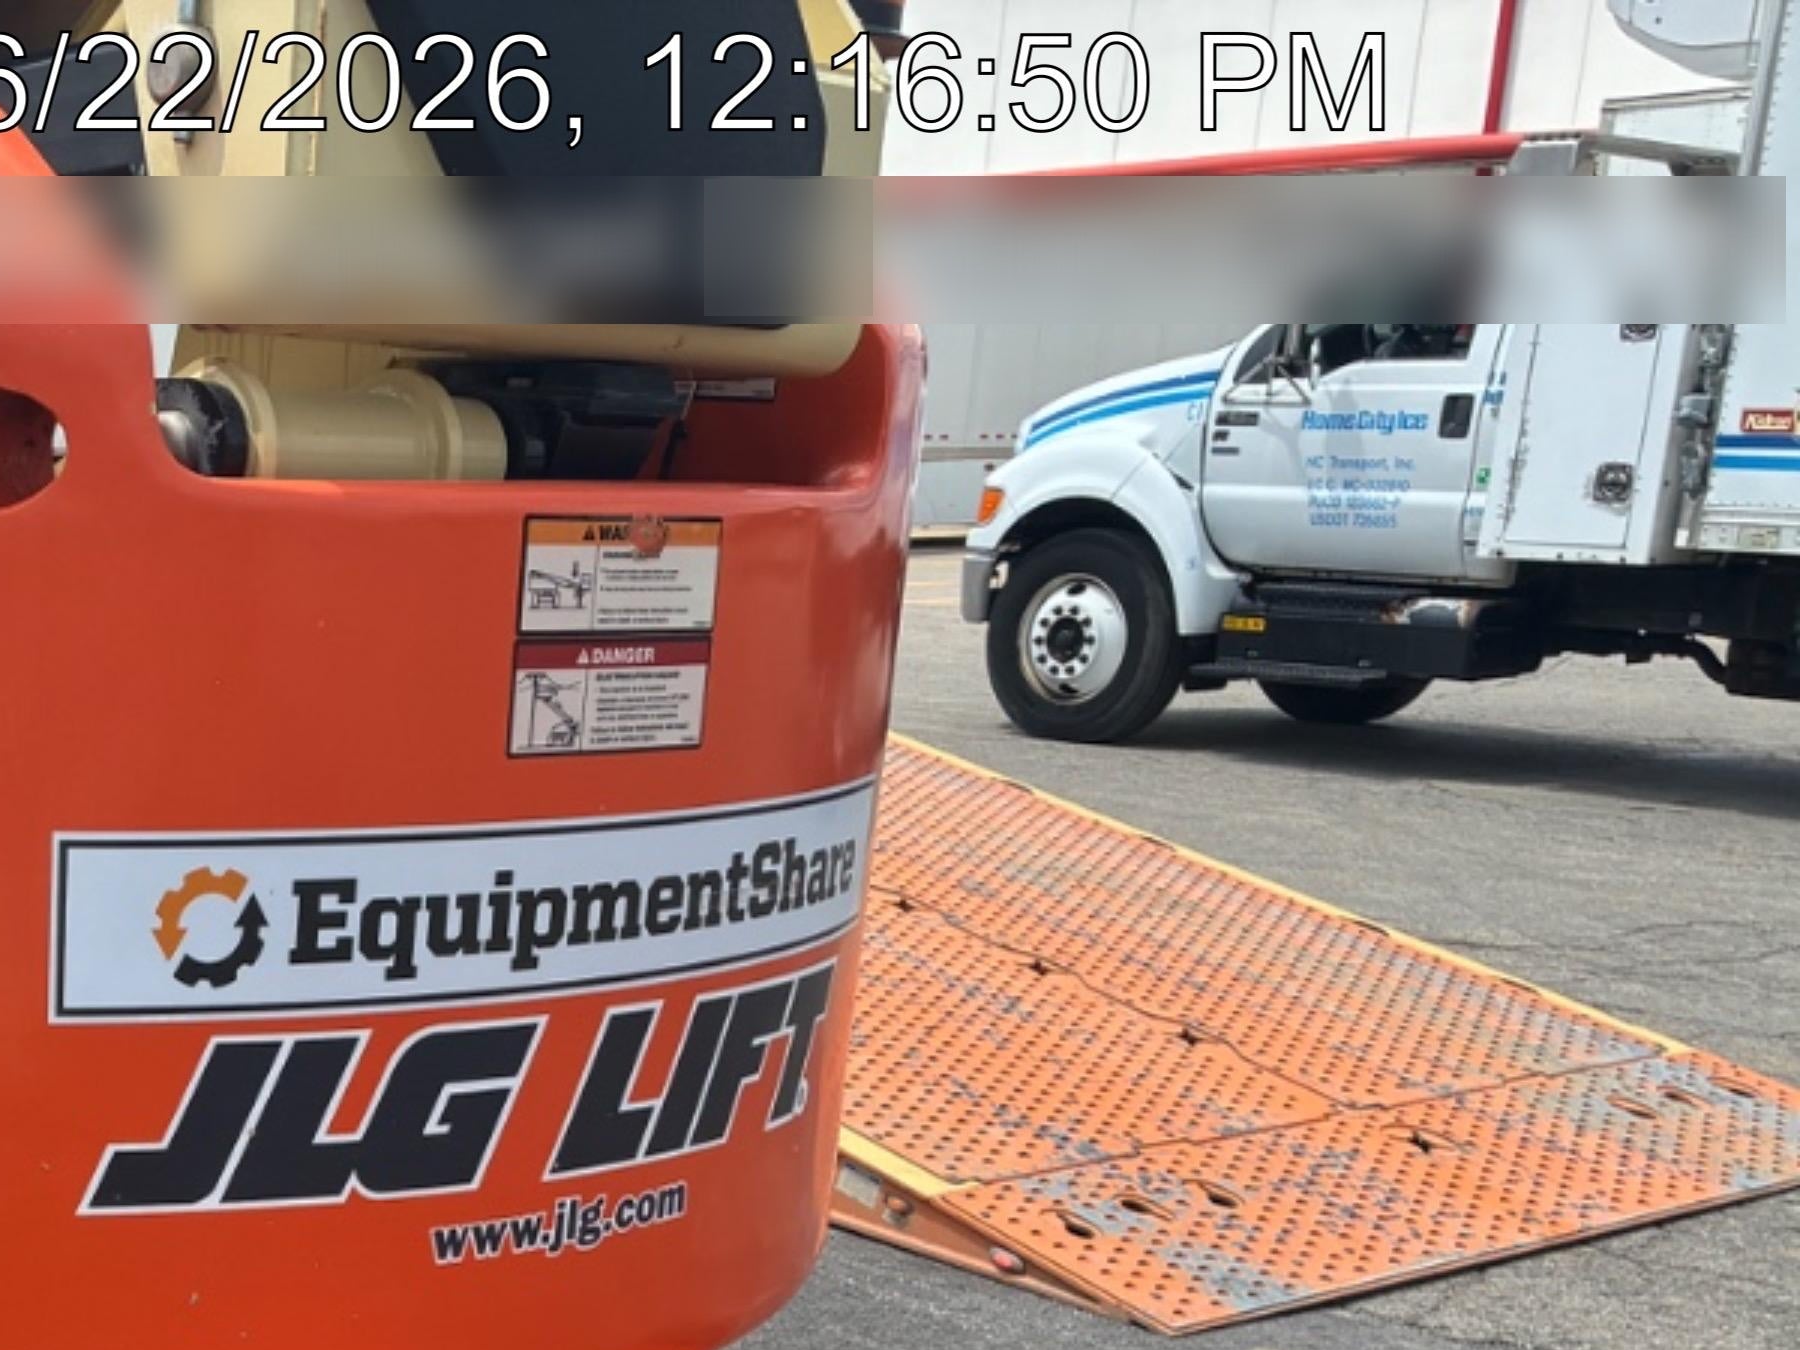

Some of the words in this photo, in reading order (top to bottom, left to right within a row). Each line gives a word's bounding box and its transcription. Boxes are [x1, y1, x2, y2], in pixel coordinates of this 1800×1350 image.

[591, 647, 655, 664] DANGER
[289, 838, 856, 983] EquipmentShare
[77, 1016, 548, 1215] JLG
[544, 957, 838, 1181] LIFT
[432, 1180, 686, 1263] www.jlg.com
